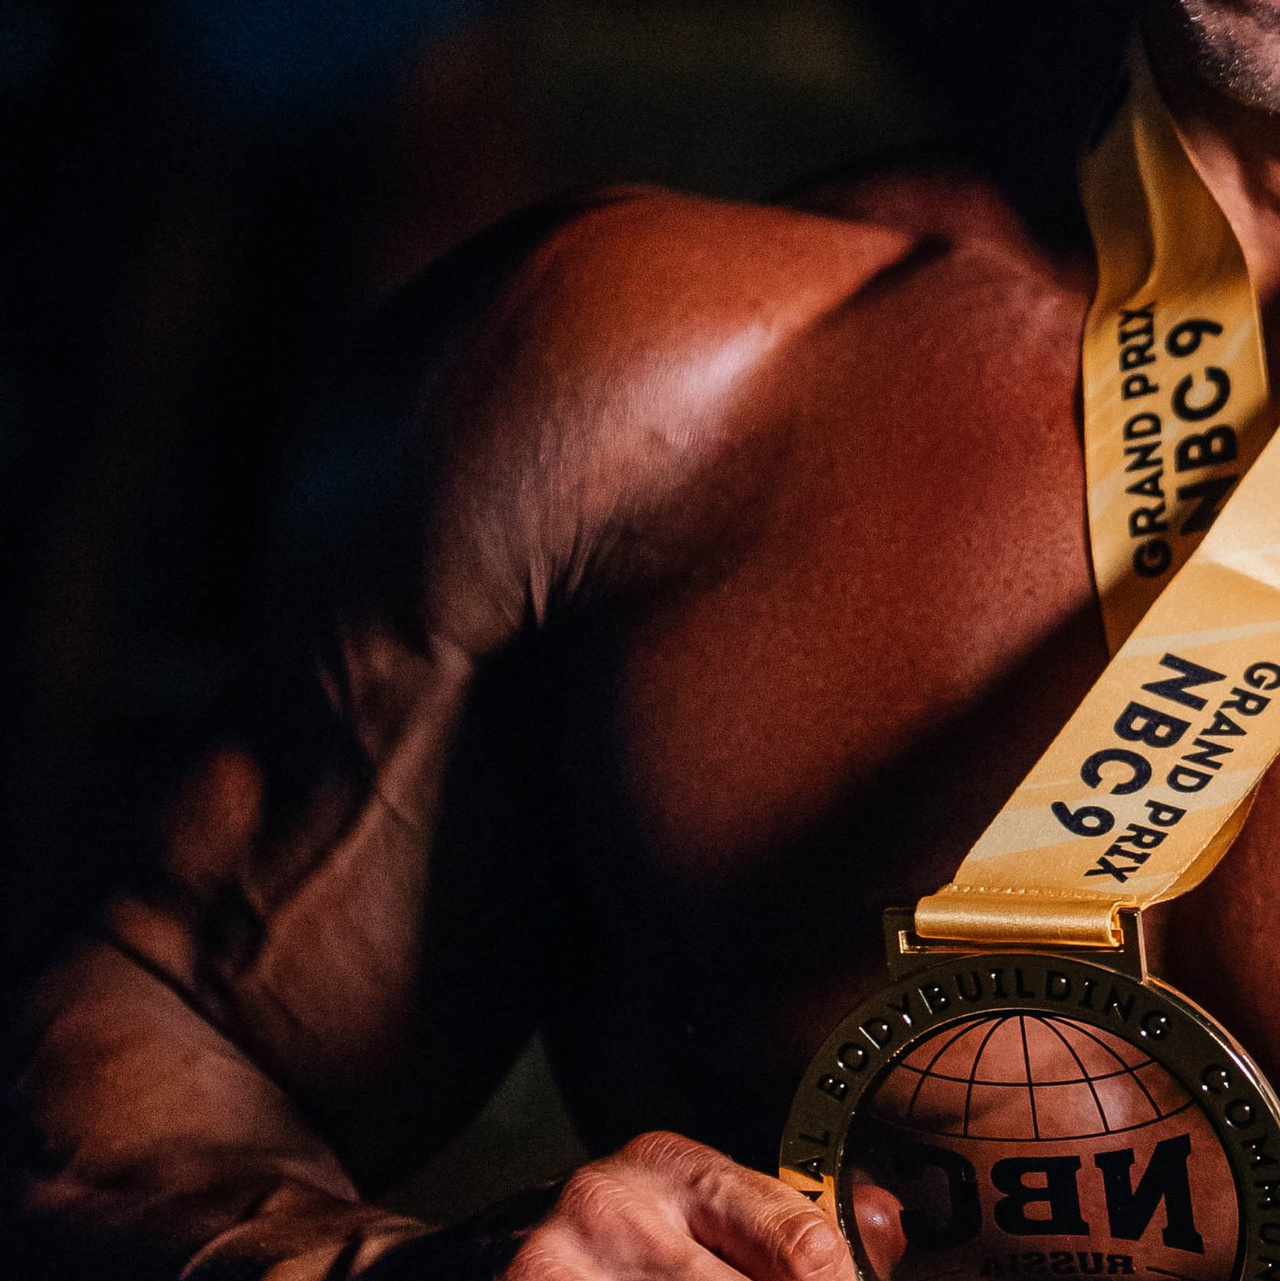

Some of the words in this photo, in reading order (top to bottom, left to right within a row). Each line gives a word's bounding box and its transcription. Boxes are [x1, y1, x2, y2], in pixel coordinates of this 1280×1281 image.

[1117, 301, 1160, 401] PRIX
[1122, 411, 1173, 578] GRAND
[1084, 799, 1187, 883] PRIX
[818, 967, 1172, 1104] BODYBUILDING
